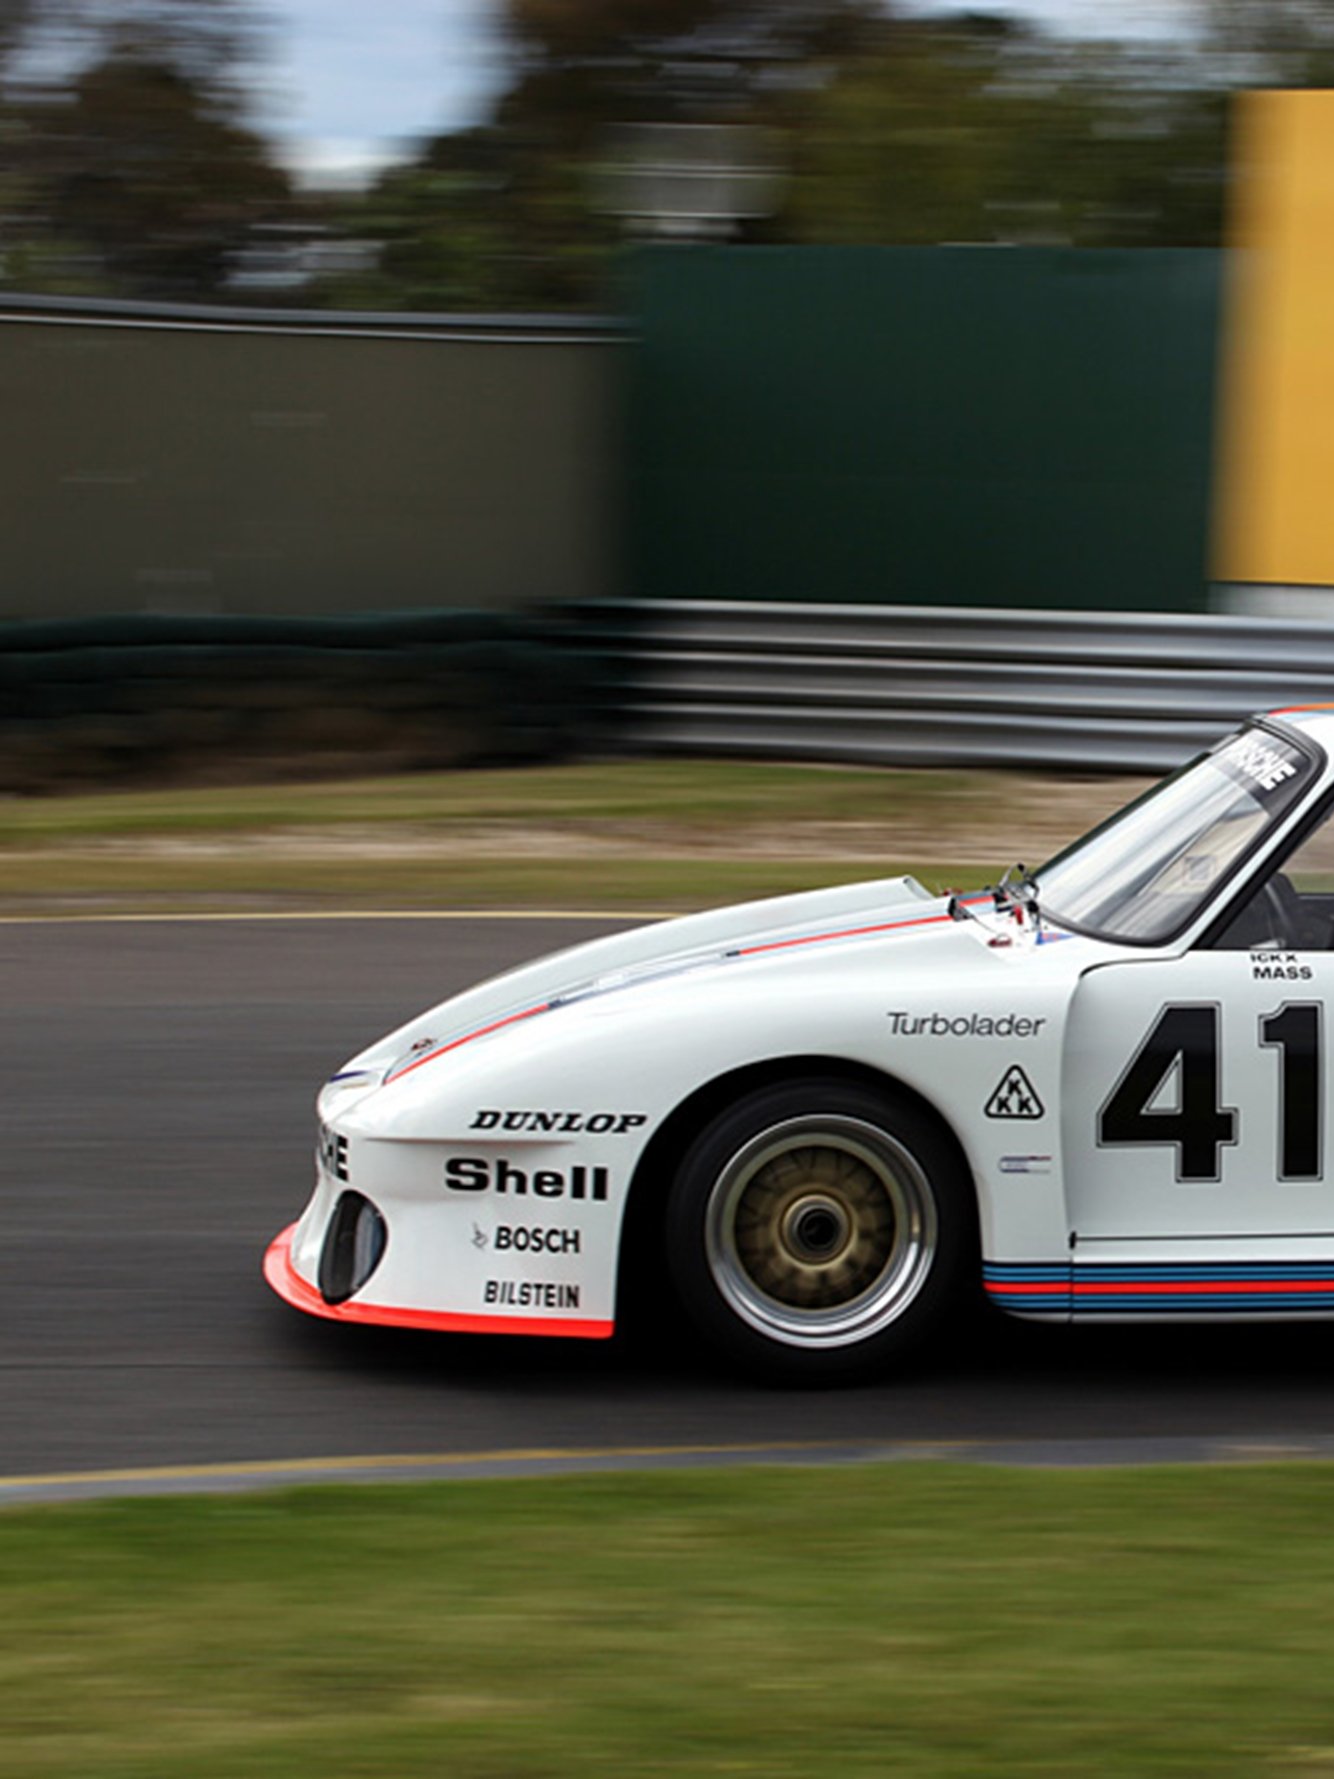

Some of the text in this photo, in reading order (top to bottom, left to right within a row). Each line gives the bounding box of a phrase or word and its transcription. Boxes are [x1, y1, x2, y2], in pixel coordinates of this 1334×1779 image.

[1253, 966, 1313, 980] MASS
[887, 1011, 1047, 1038] Turbolader
[1097, 1001, 1324, 1182] 41
[468, 1110, 648, 1134] DUNLOP
[445, 1157, 608, 1202] Shell
[494, 1226, 581, 1254] BOSCH
[484, 1280, 581, 1308] BILSTEIN
